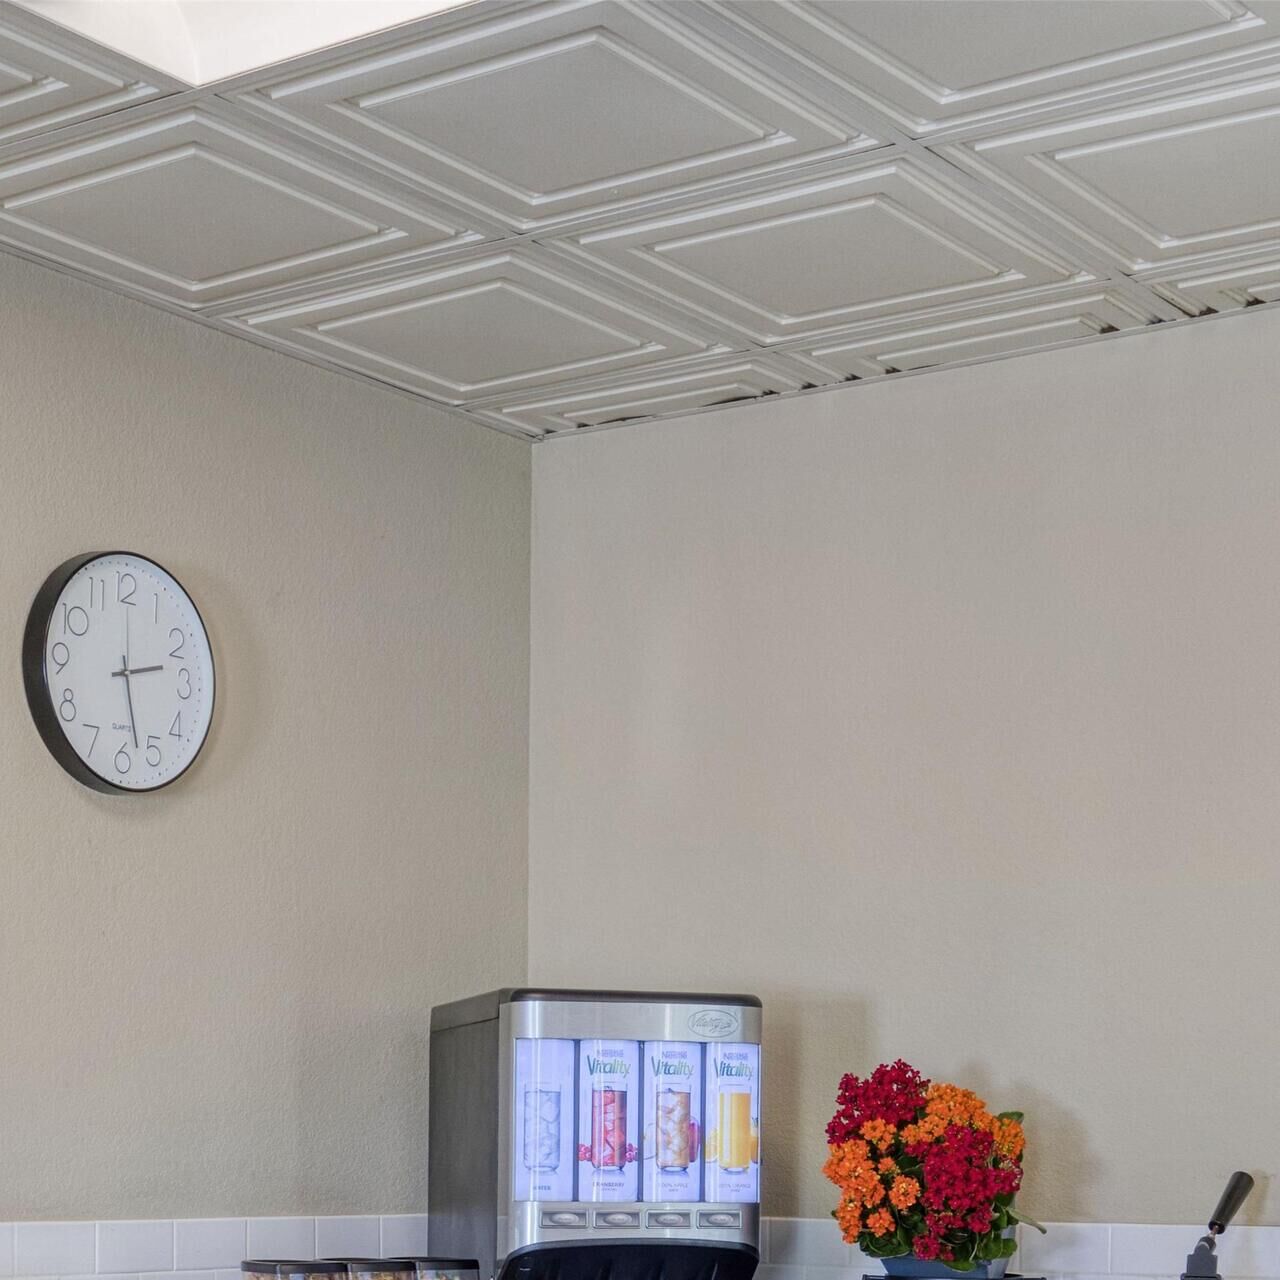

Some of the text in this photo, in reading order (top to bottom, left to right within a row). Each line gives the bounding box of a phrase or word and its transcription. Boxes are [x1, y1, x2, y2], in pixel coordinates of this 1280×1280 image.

[89, 576, 104, 611] 11
[116, 570, 136, 606] 12
[62, 602, 89, 636] 10
[153, 592, 158, 624] 1
[51, 642, 70, 675] 9
[169, 628, 185, 660] 2
[176, 667, 191, 700] 3
[59, 688, 76, 722] 8
[82, 723, 100, 758] 7
[168, 710, 183, 741] 4
[114, 741, 131, 774] 6
[145, 735, 162, 767] 5
[586, 1054, 631, 1079] Vitality
[651, 1055, 694, 1079] Vitality
[713, 1056, 753, 1081] Vitality
